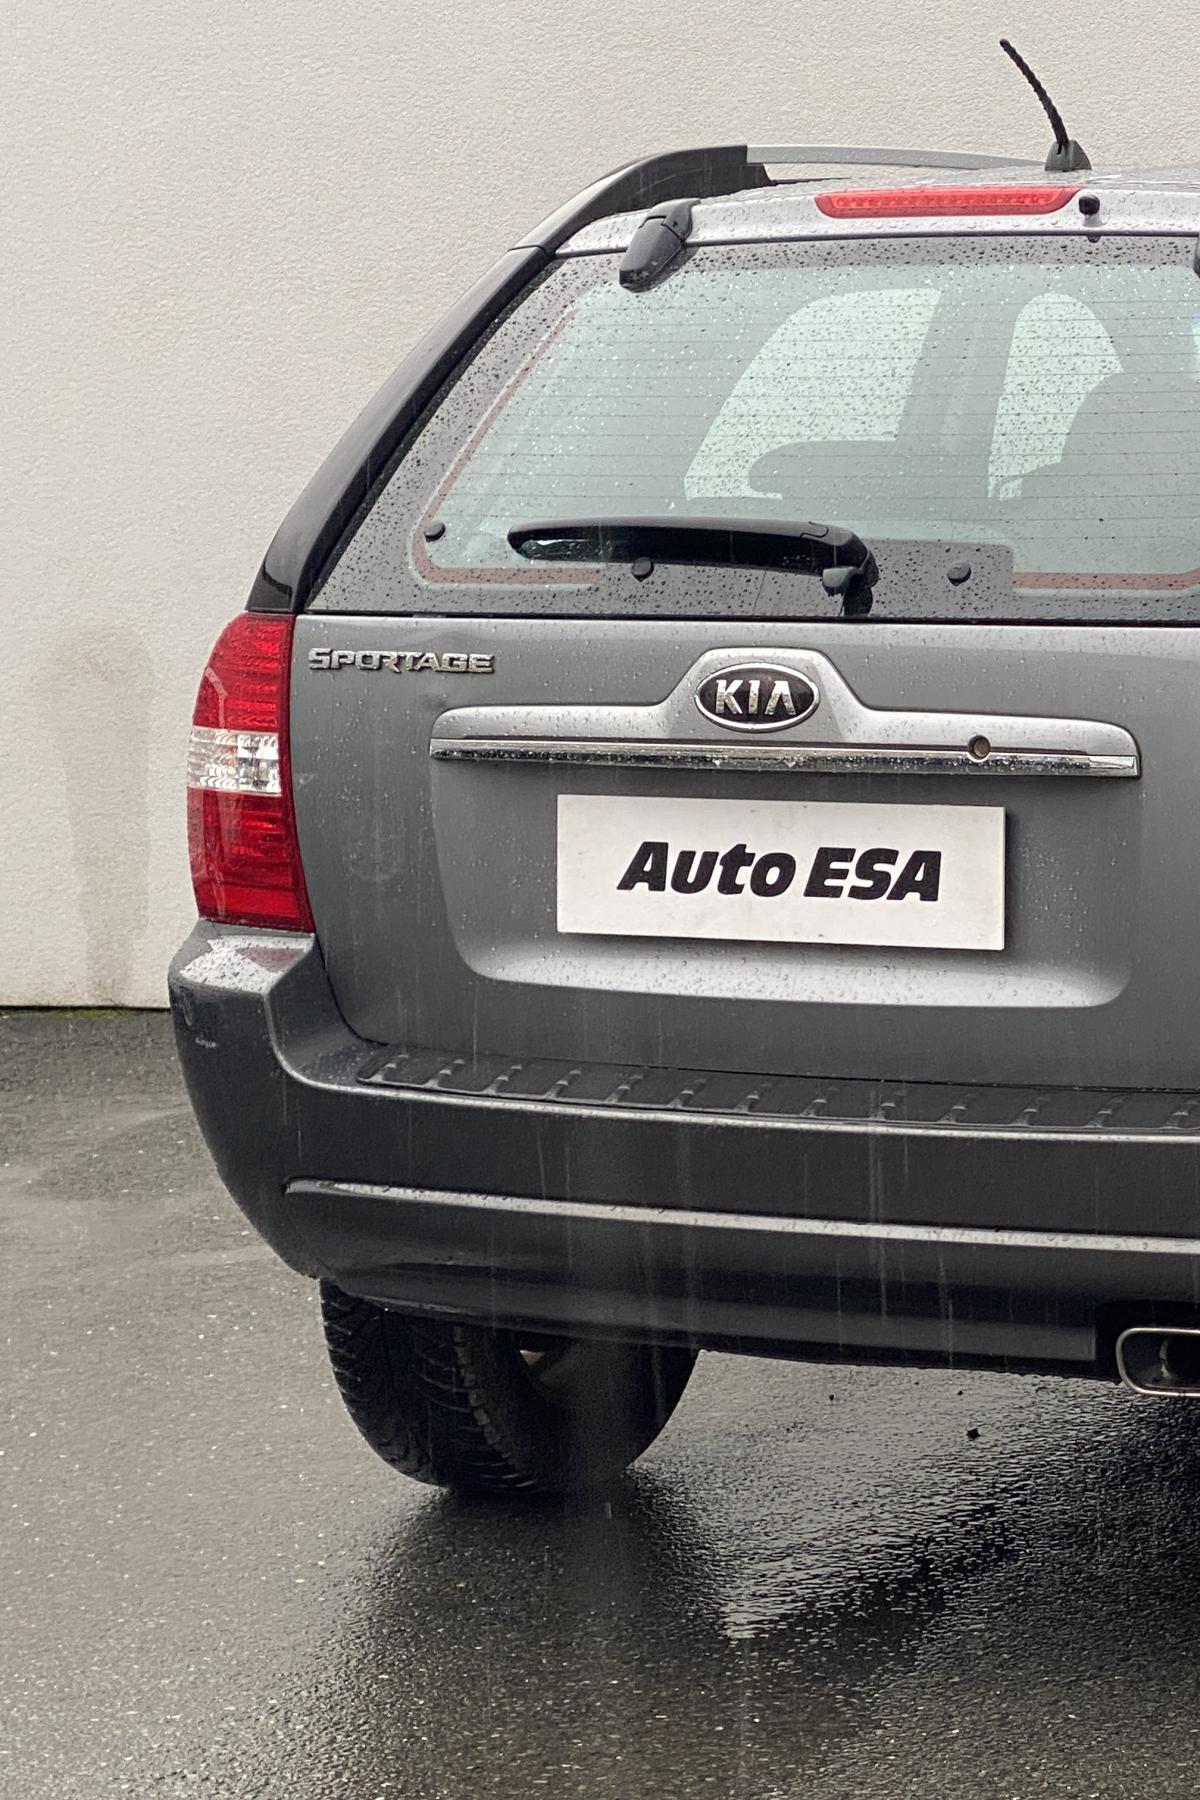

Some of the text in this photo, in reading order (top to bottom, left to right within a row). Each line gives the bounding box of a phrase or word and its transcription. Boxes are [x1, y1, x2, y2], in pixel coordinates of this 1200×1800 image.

[307, 647, 496, 673] SPORTAGE
[715, 679, 797, 716] KIA
[616, 841, 942, 902] Auto ESA
